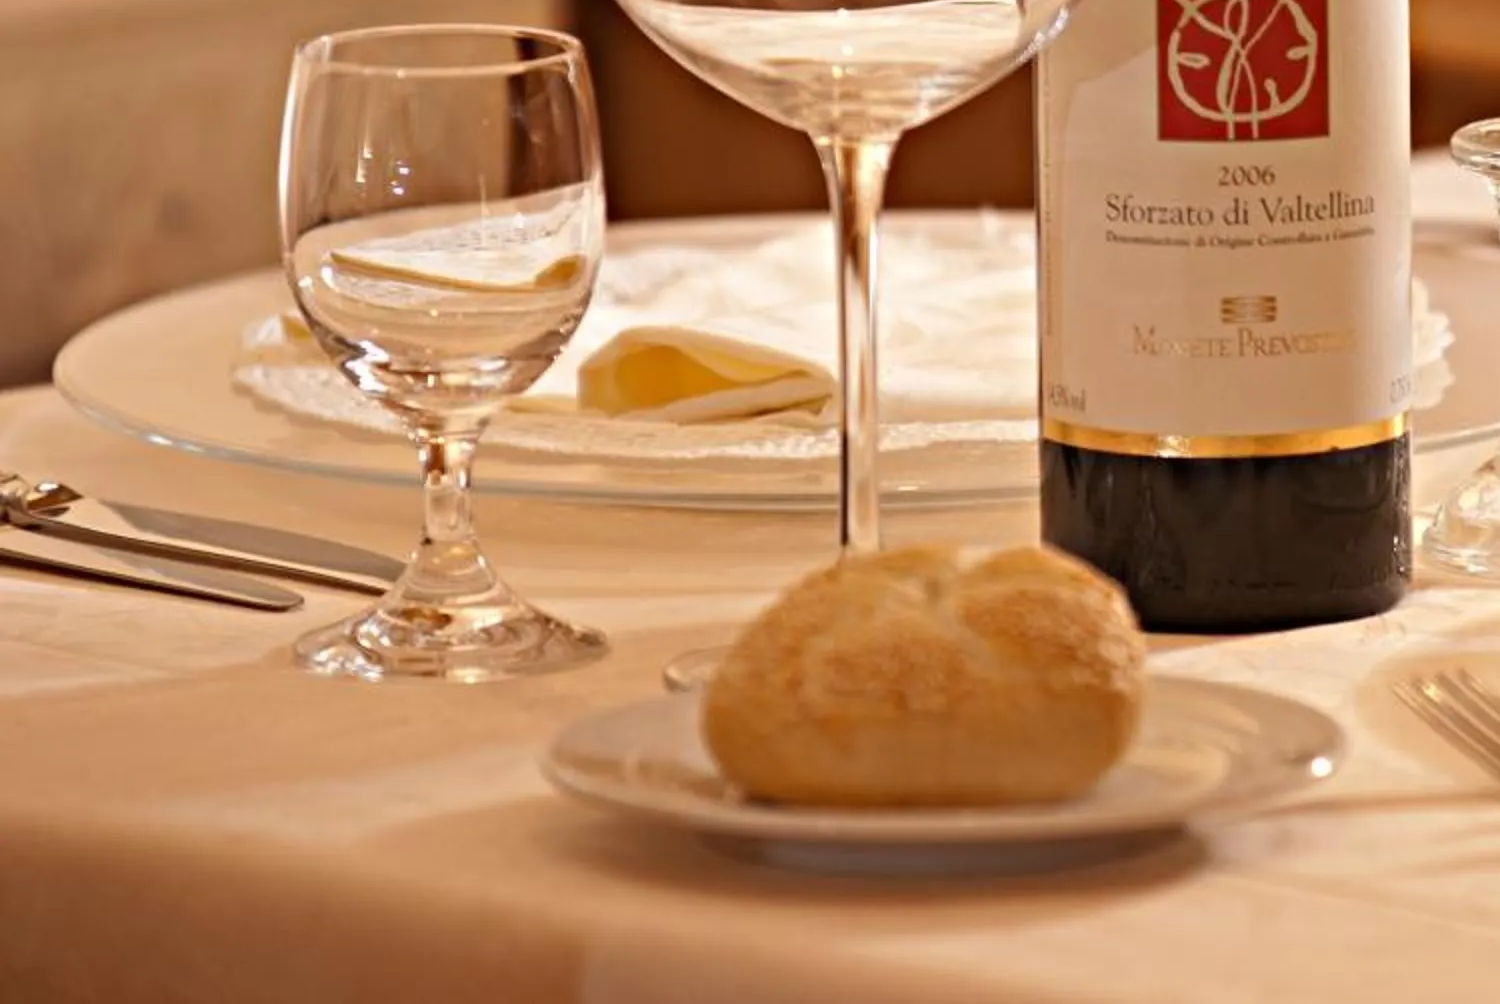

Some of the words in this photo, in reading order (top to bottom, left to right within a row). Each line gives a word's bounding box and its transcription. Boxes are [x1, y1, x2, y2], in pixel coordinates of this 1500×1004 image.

[1218, 165, 1276, 187] 2006
[1105, 193, 1214, 226] Sforzato
[1223, 196, 1249, 226] di
[1260, 190, 1375, 224] Valtellina
